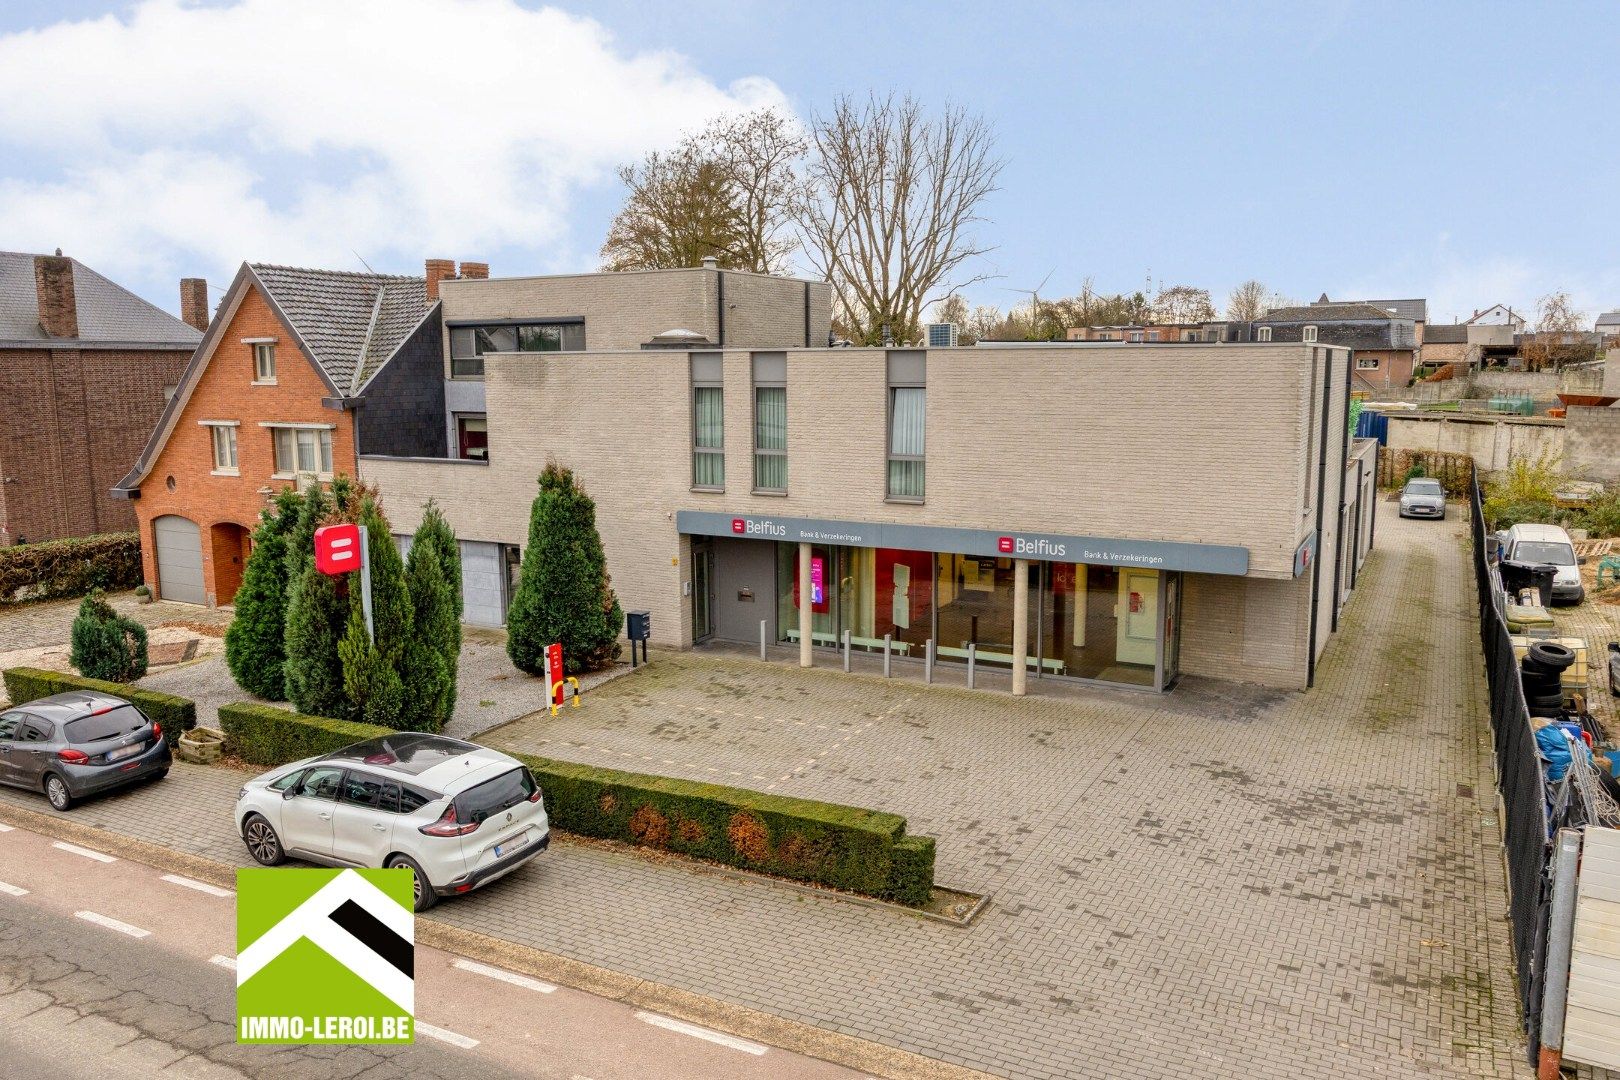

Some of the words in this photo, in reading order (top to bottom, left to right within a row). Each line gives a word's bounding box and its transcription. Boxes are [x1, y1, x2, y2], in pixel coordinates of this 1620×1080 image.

[746, 520, 786, 536] Belfius
[800, 530, 814, 538] Bank
[820, 532, 862, 542] Verzekeringen
[1016, 538, 1066, 556] Belfius
[1084, 550, 1101, 559] Bank
[1103, 552, 1109, 560] &
[1110, 552, 1163, 564] Verzekeringen
